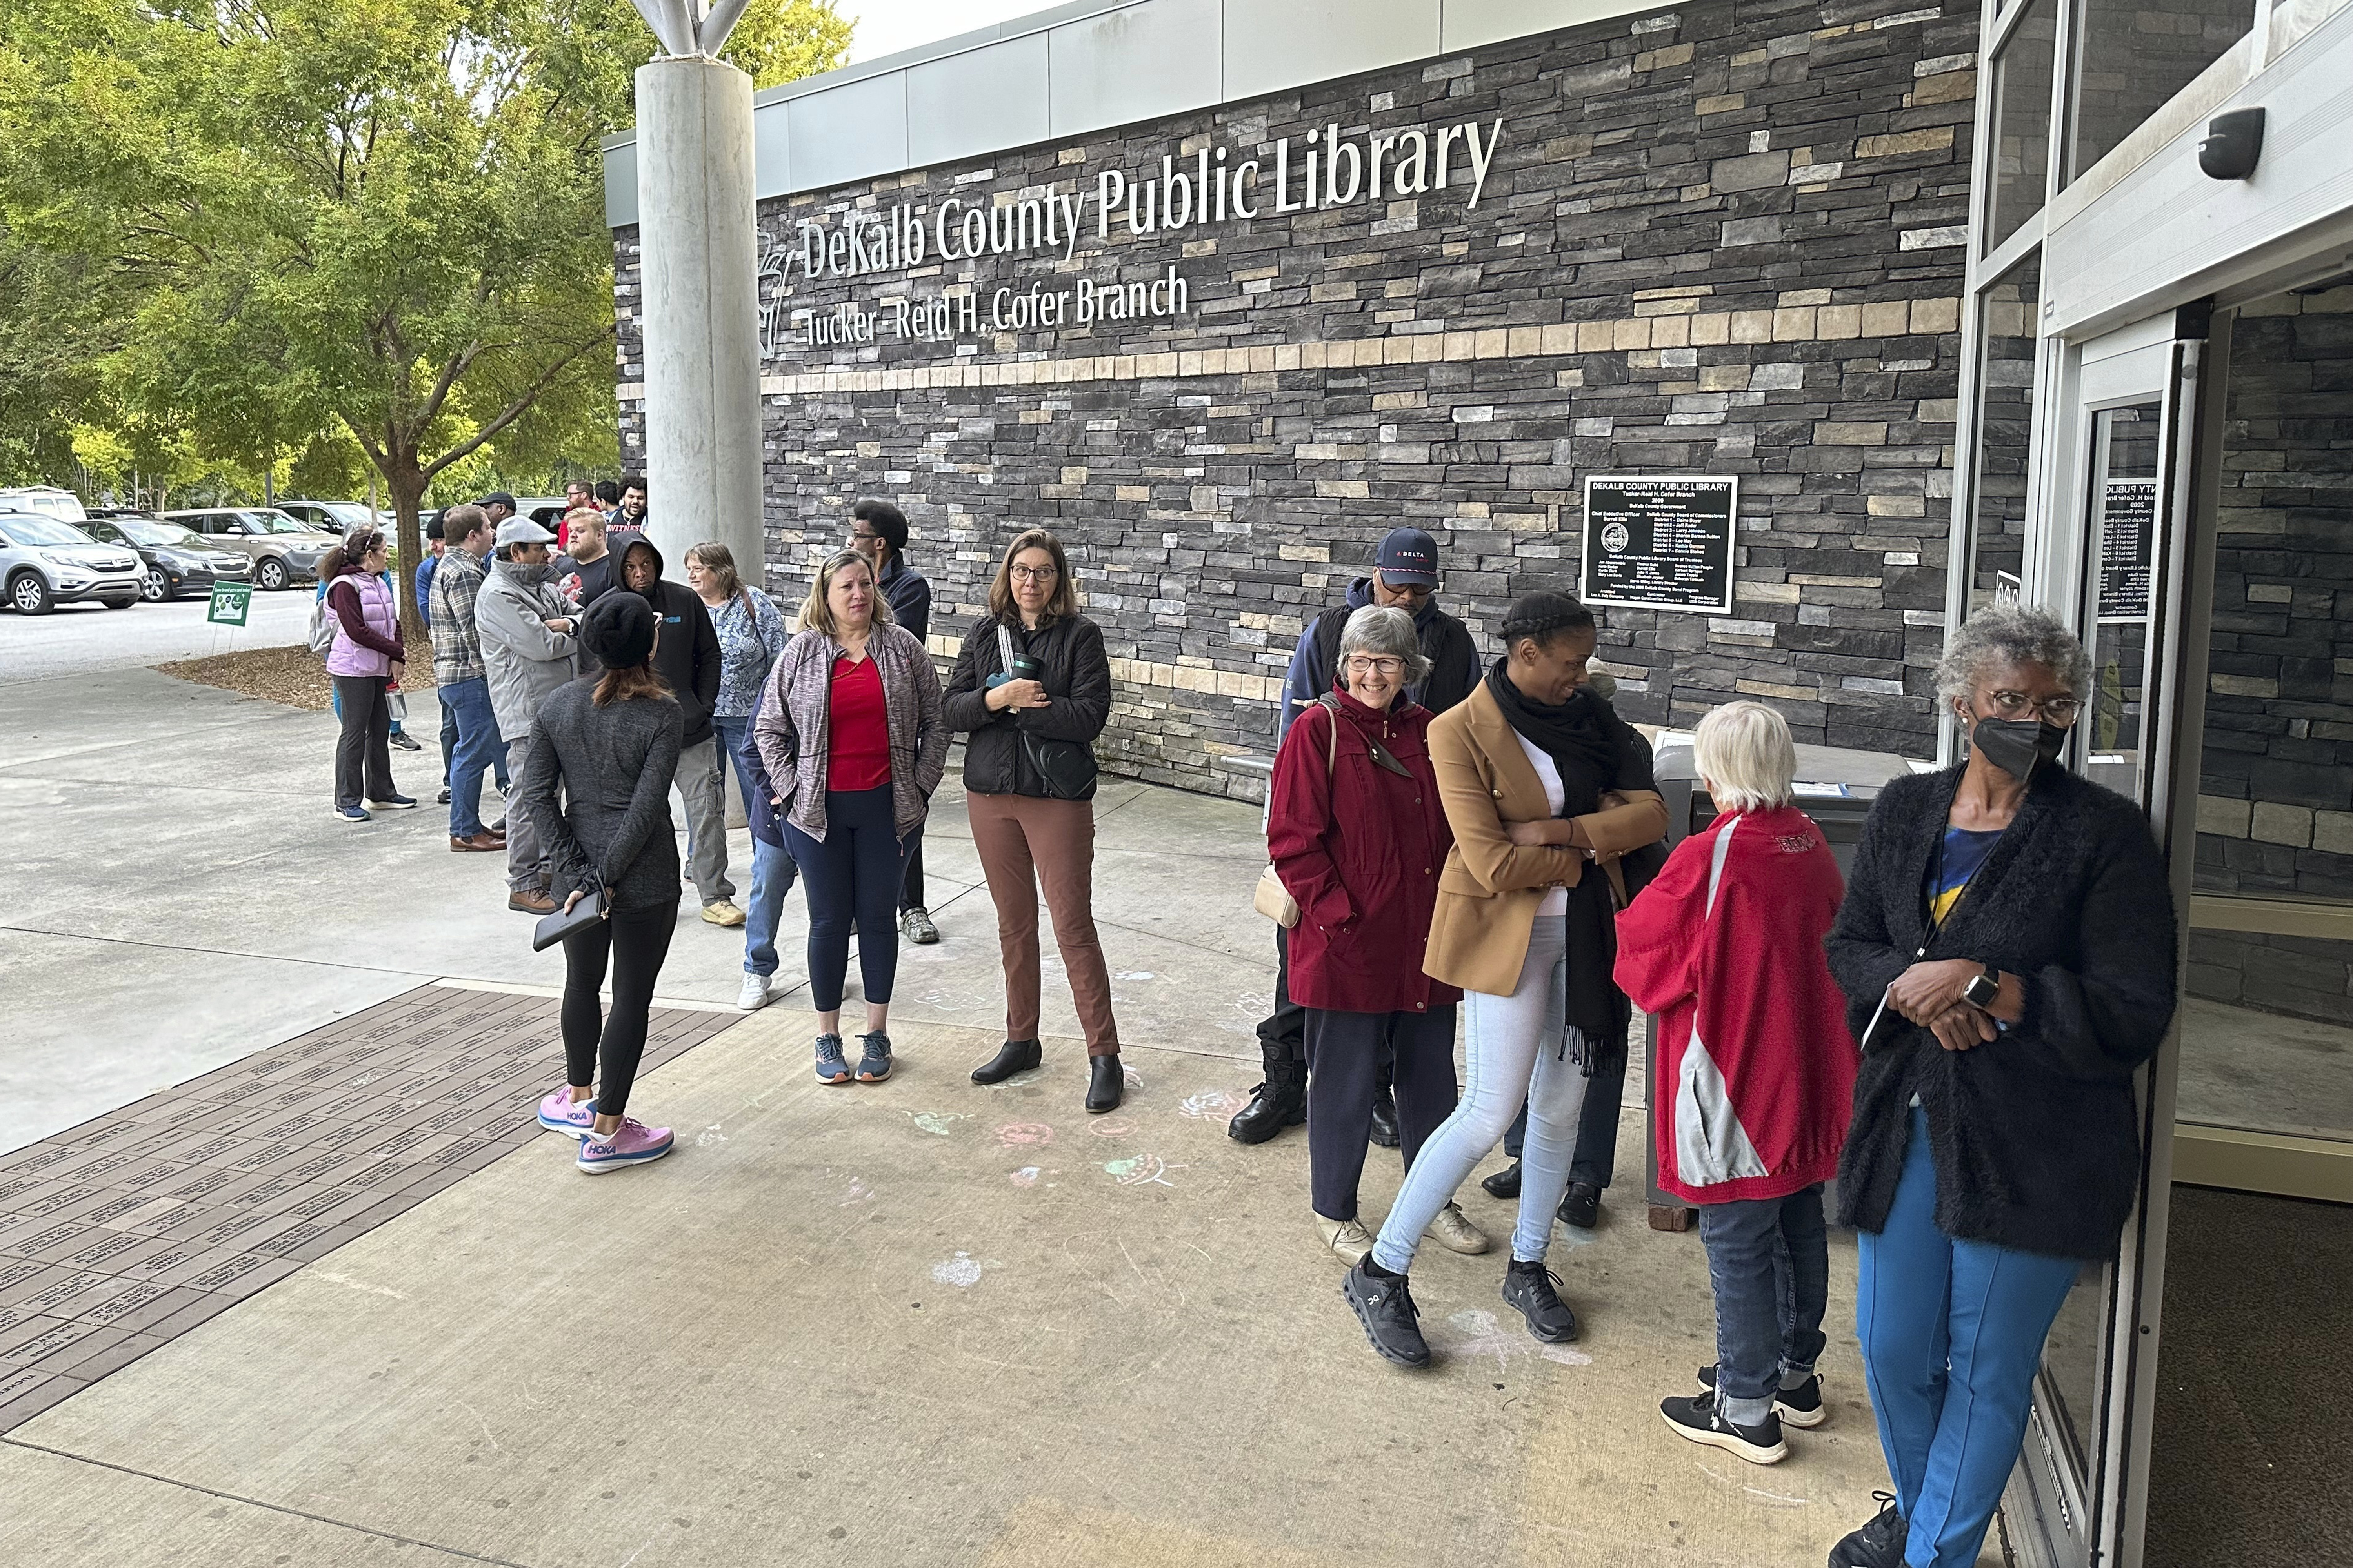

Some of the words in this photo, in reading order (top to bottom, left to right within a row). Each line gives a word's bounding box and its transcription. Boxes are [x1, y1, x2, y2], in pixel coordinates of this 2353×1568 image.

[796, 203, 925, 278] DeKalb
[936, 186, 1085, 262] County
[1098, 146, 1259, 238] Public
[1276, 118, 1503, 211] Library
[805, 309, 877, 345] Tucker
[896, 295, 950, 338] Reid
[958, 292, 986, 333] H.
[993, 281, 1069, 330] Cofer
[1076, 265, 1187, 323] Branch
[587, 1145, 616, 1154] HOKA
[107, 1201, 142, 1217] MEMORY
[145, 1207, 187, 1227] ANDERSON
[167, 1212, 196, 1225] HONOR
[231, 1216, 257, 1228] TUCKER
[205, 1228, 232, 1241] GARDEN
[289, 1225, 319, 1239] EVENING
[294, 1223, 313, 1232] CLUB
[300, 1225, 329, 1239] TUCKER
[38, 1231, 74, 1248] MEMORY
[93, 1237, 133, 1255] STRENGTH
[112, 1238, 140, 1250] HAYES
[268, 1240, 290, 1250] BOOK
[274, 1239, 302, 1253] LIBRARY
[71, 1237, 124, 1260] KNOWLEDGE
[85, 1250, 113, 1264] FAMILY
[145, 1254, 169, 1265] CLUB
[154, 1254, 189, 1270] TUCKER
[210, 1256, 248, 1275] ALLIANCE
[237, 1259, 260, 1272] JANIS
[69, 1273, 89, 1283] PAST
[191, 1275, 211, 1284] 2011
[198, 1268, 235, 1286] FRIENDS
[210, 1271, 236, 1285] JONES
[23, 1286, 60, 1306] PRESENT
[40, 1279, 87, 1302] LIBRARIANS
[60, 1286, 84, 1296] LOVE
[121, 1285, 149, 1299] COFER
[147, 1287, 166, 1295] THE
[42, 1297, 61, 1306] OUR
[88, 1299, 122, 1317] LIBRARY
[114, 1295, 149, 1314] FRIENDS
[56, 1324, 75, 1333] OUR
[38, 1333, 58, 1343] NEW
[5, 1343, 39, 1360] LIBRARY
[29, 1340, 65, 1357] FRIENDS
